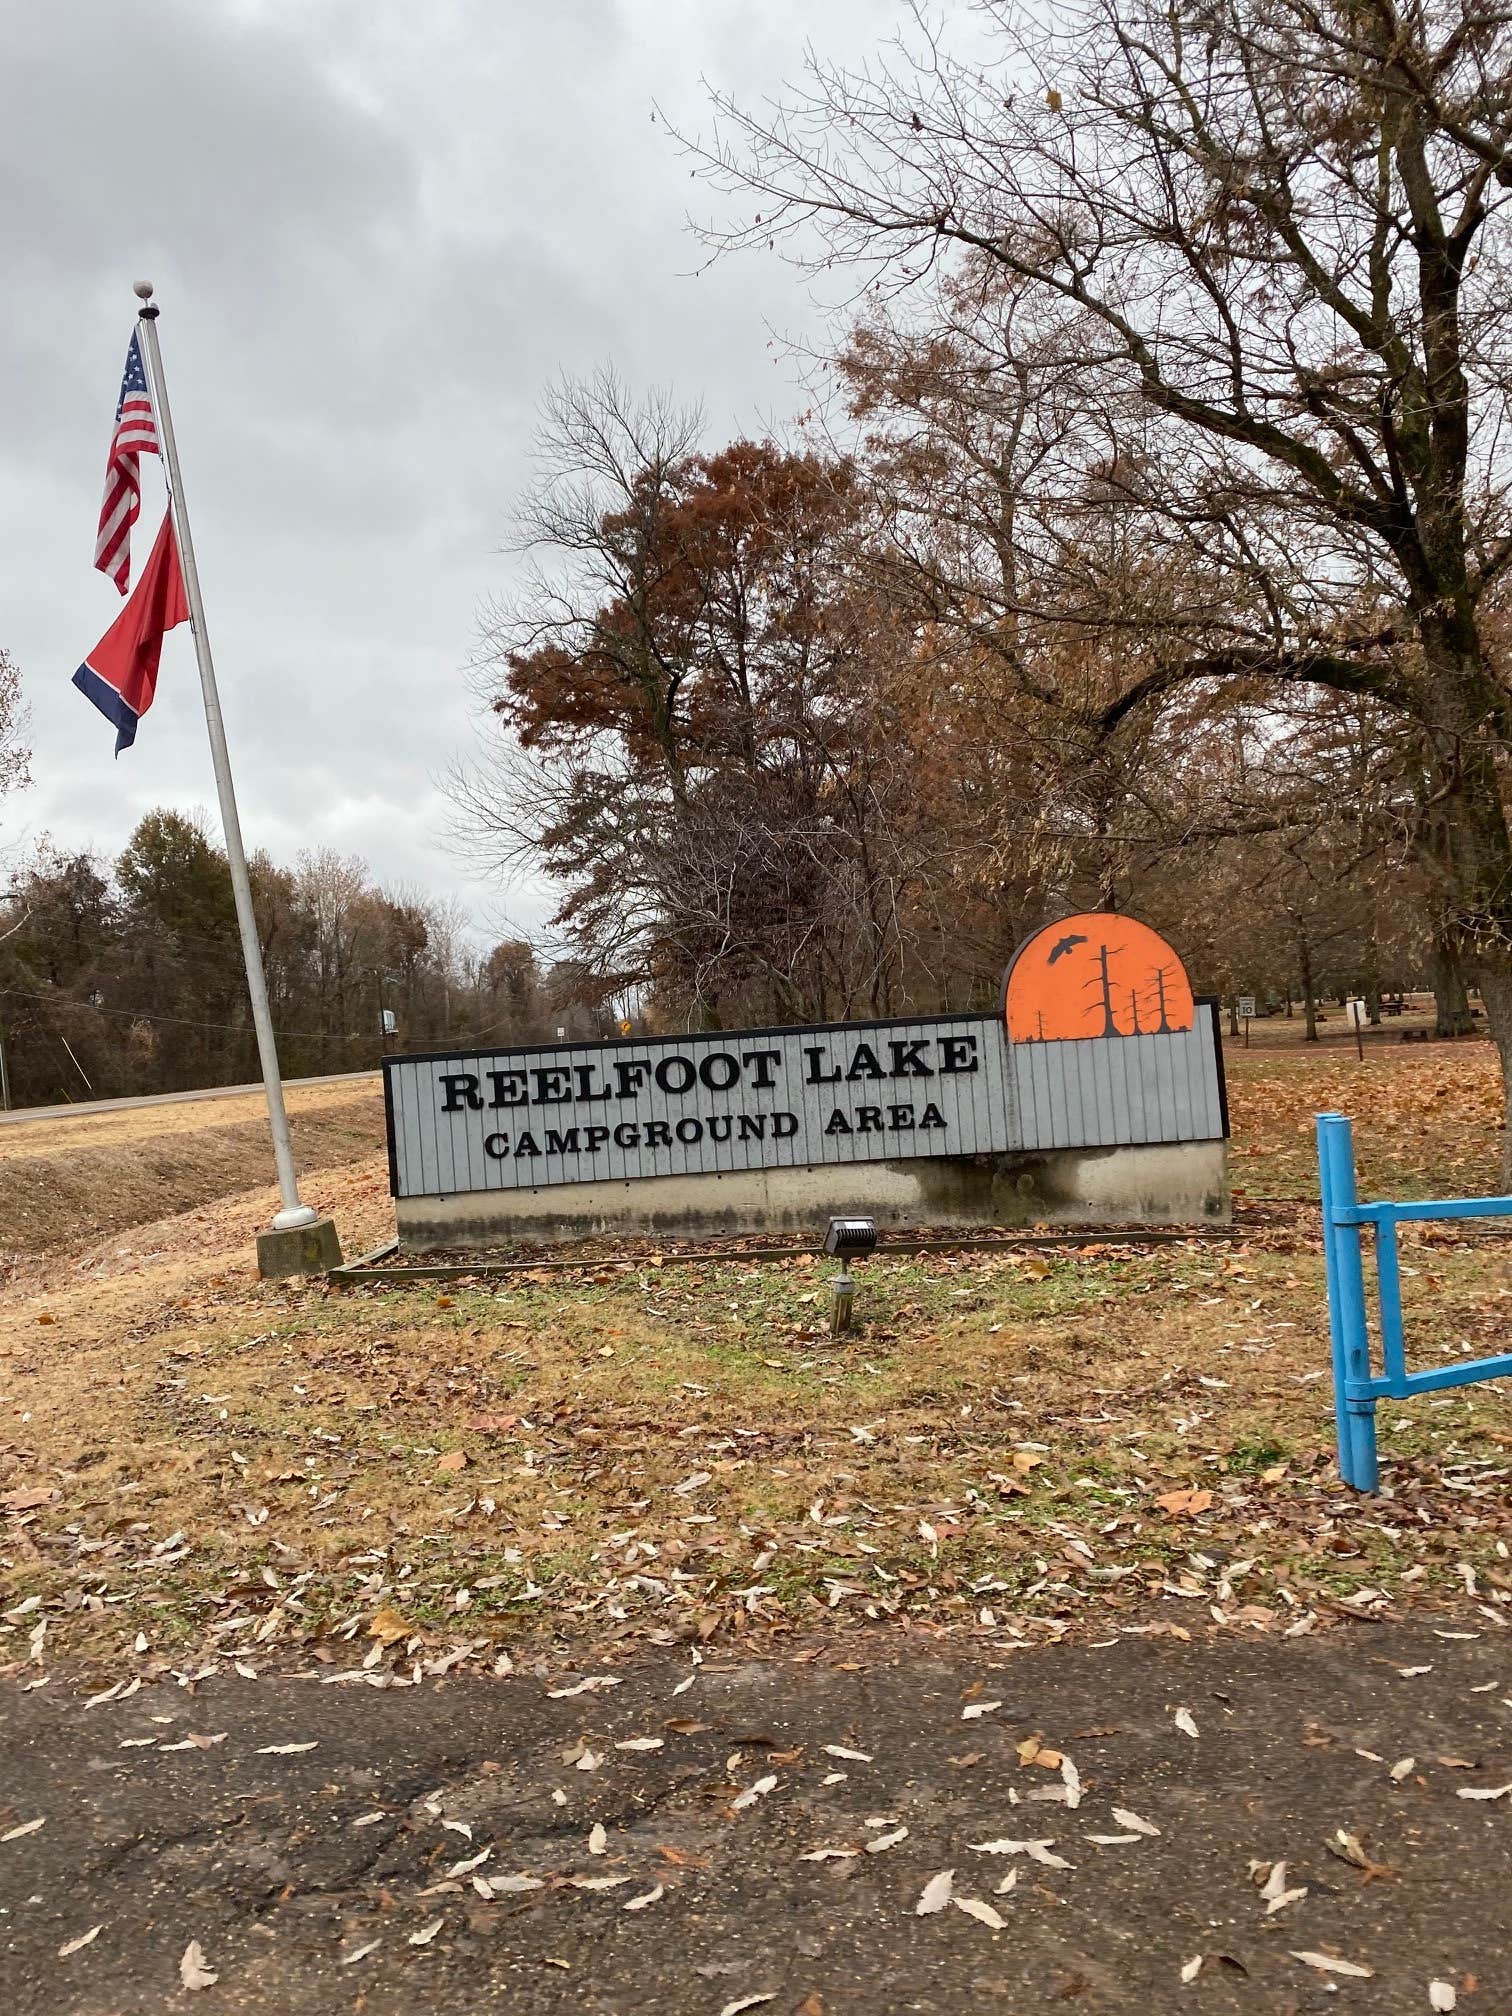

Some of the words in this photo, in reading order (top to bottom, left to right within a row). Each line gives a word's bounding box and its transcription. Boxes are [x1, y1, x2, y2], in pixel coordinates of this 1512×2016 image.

[438, 1050, 782, 1113] REELFOOT
[804, 1036, 978, 1086] LAKE
[484, 1112, 799, 1159] CAMPGROUND
[825, 1103, 948, 1135] AREA
